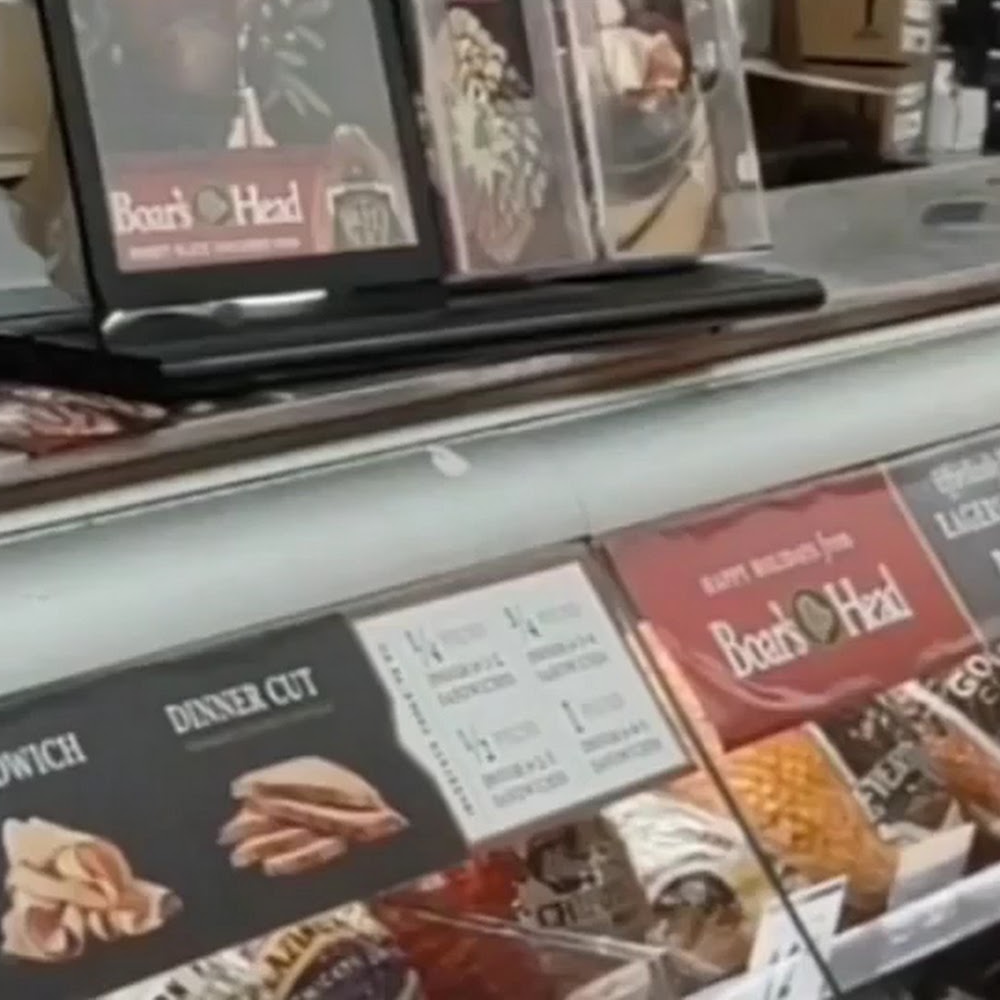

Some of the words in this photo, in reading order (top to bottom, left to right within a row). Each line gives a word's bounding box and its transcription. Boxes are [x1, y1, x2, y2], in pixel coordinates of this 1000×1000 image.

[110, 186, 193, 234] Boar's
[229, 180, 304, 228] Head
[707, 600, 808, 680] Boar's
[822, 562, 914, 637] Head
[164, 683, 268, 735] DINNER
[264, 667, 319, 707] CUT
